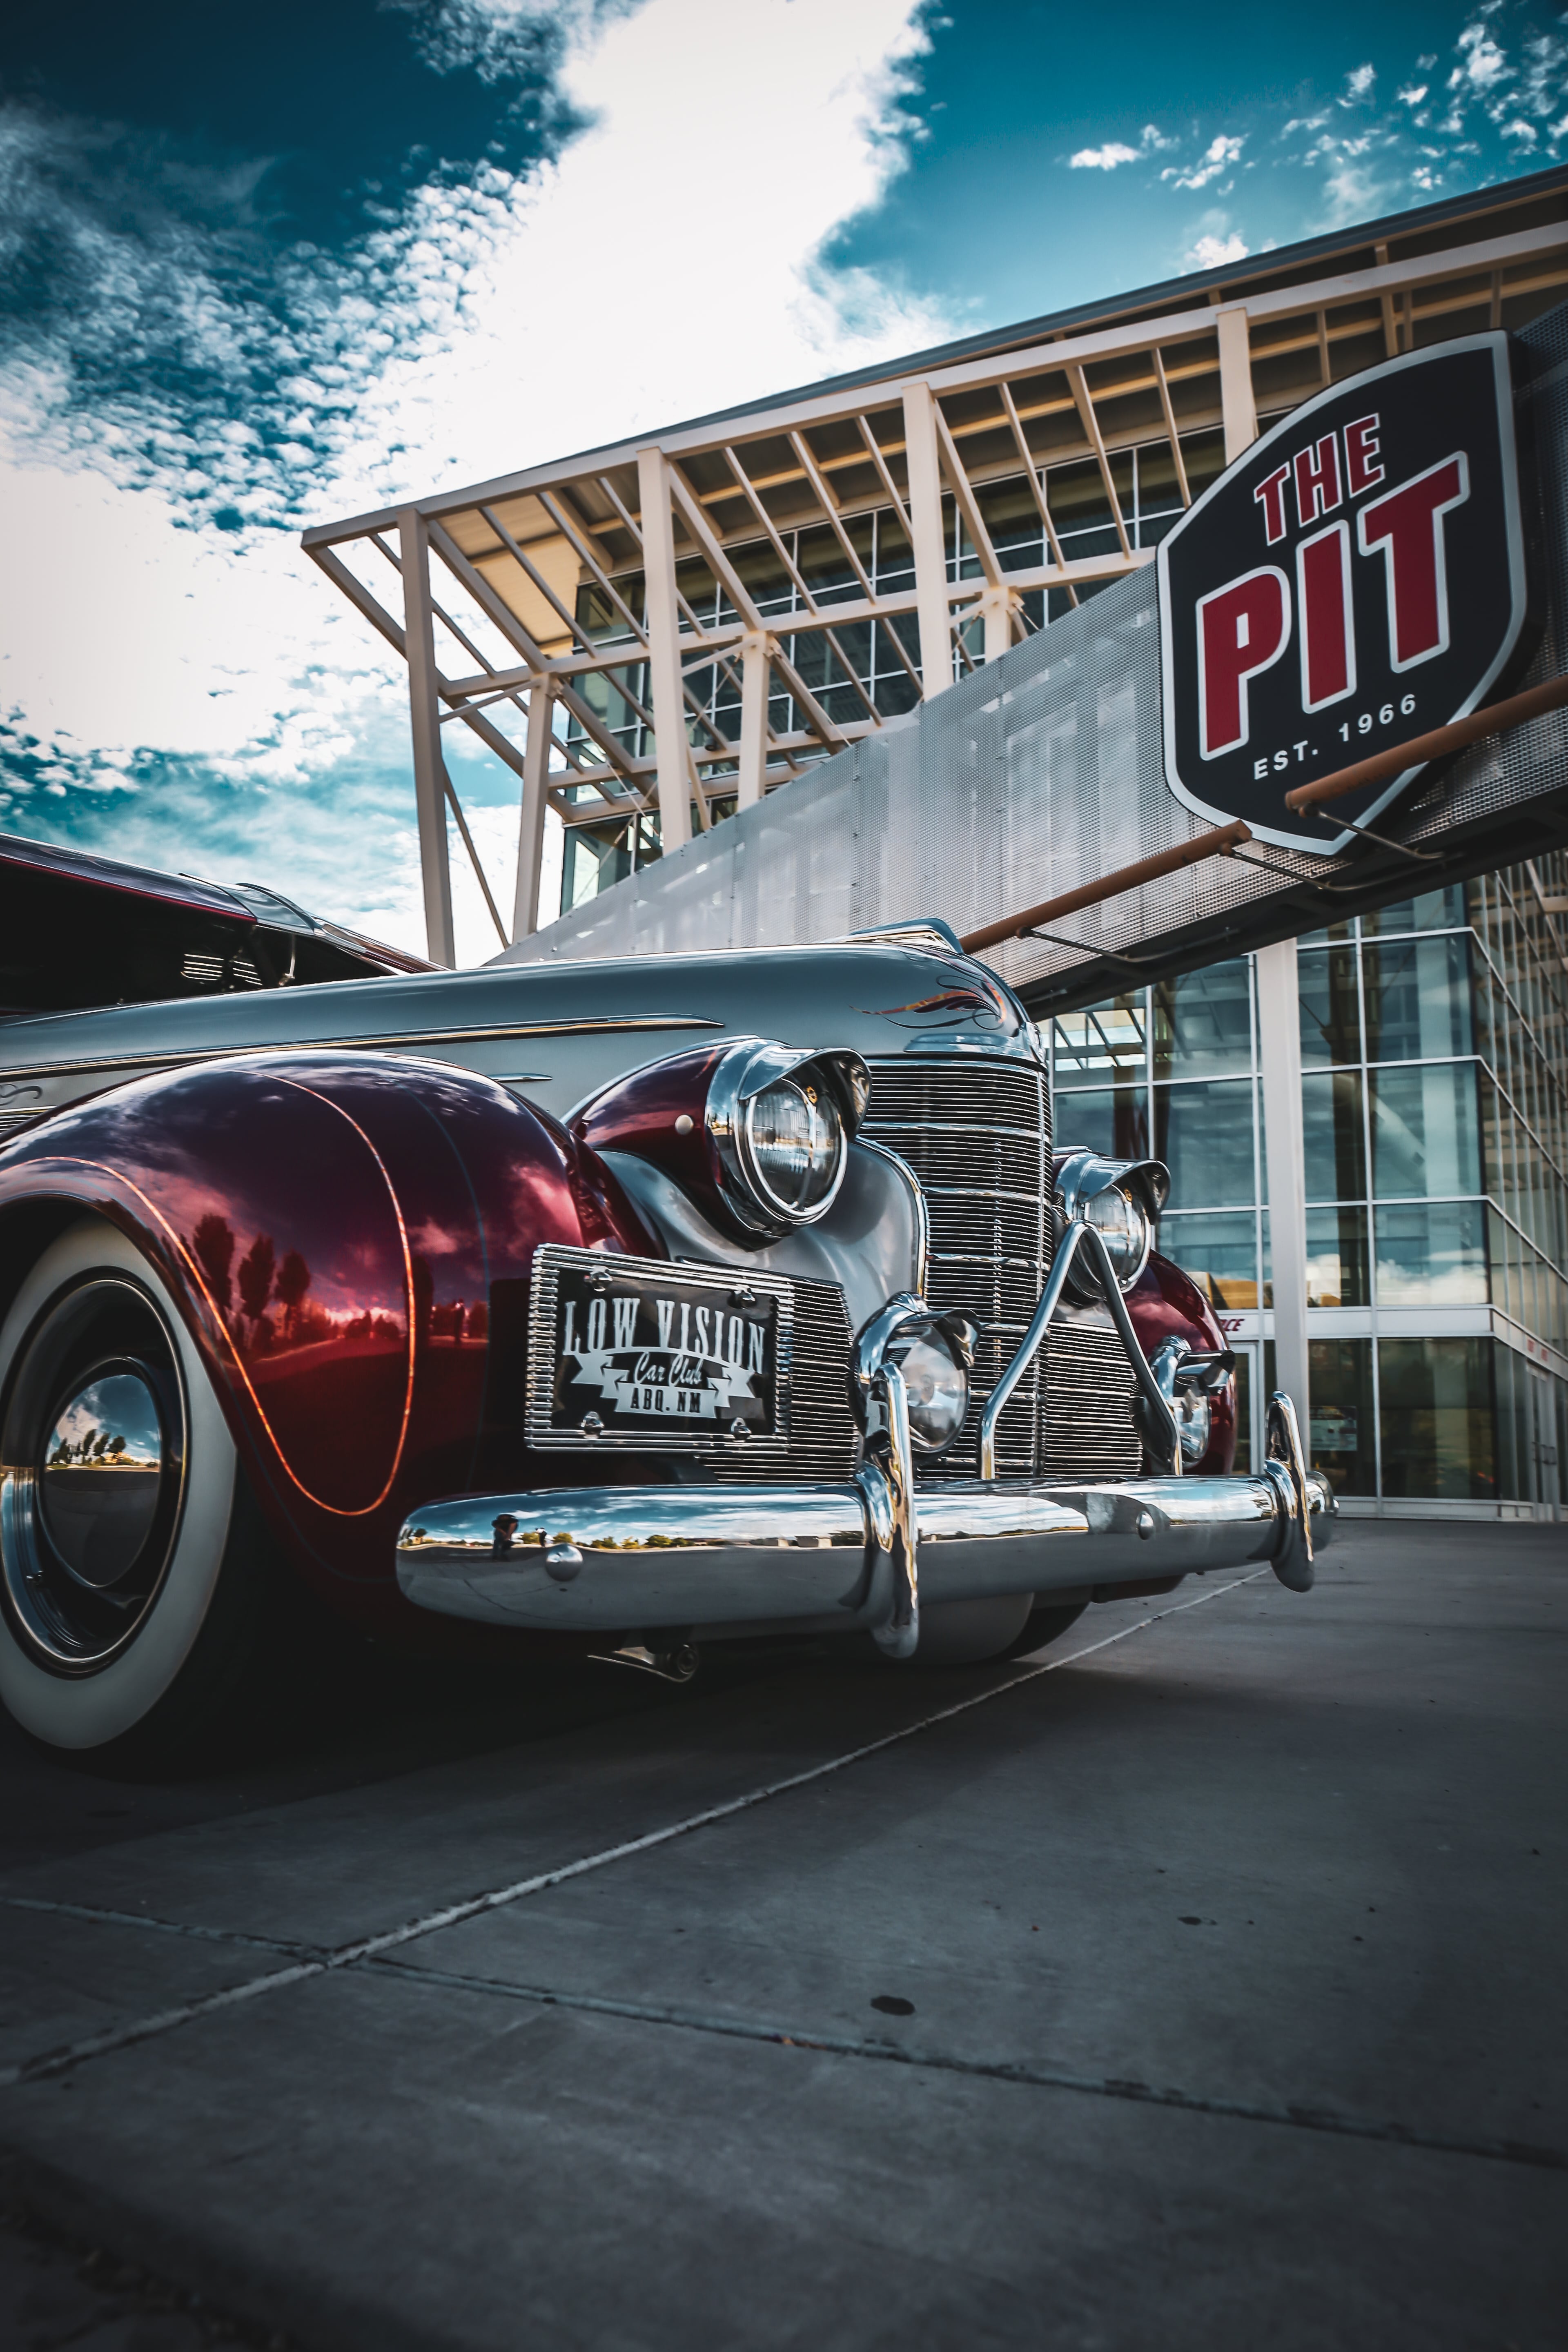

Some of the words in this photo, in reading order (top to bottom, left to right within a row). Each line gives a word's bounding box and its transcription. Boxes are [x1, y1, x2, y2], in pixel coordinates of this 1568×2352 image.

[1254, 412, 1386, 546] THE
[1195, 450, 1470, 761] PIT
[1254, 740, 1319, 780] EST.
[1338, 693, 1416, 742] 1966
[562, 1298, 641, 1356] LOW
[656, 1299, 765, 1374] VISION
[634, 1351, 666, 1384] Car
[668, 1353, 702, 1387] Club
[630, 1387, 670, 1412] ABQ.
[677, 1391, 701, 1413] NM
